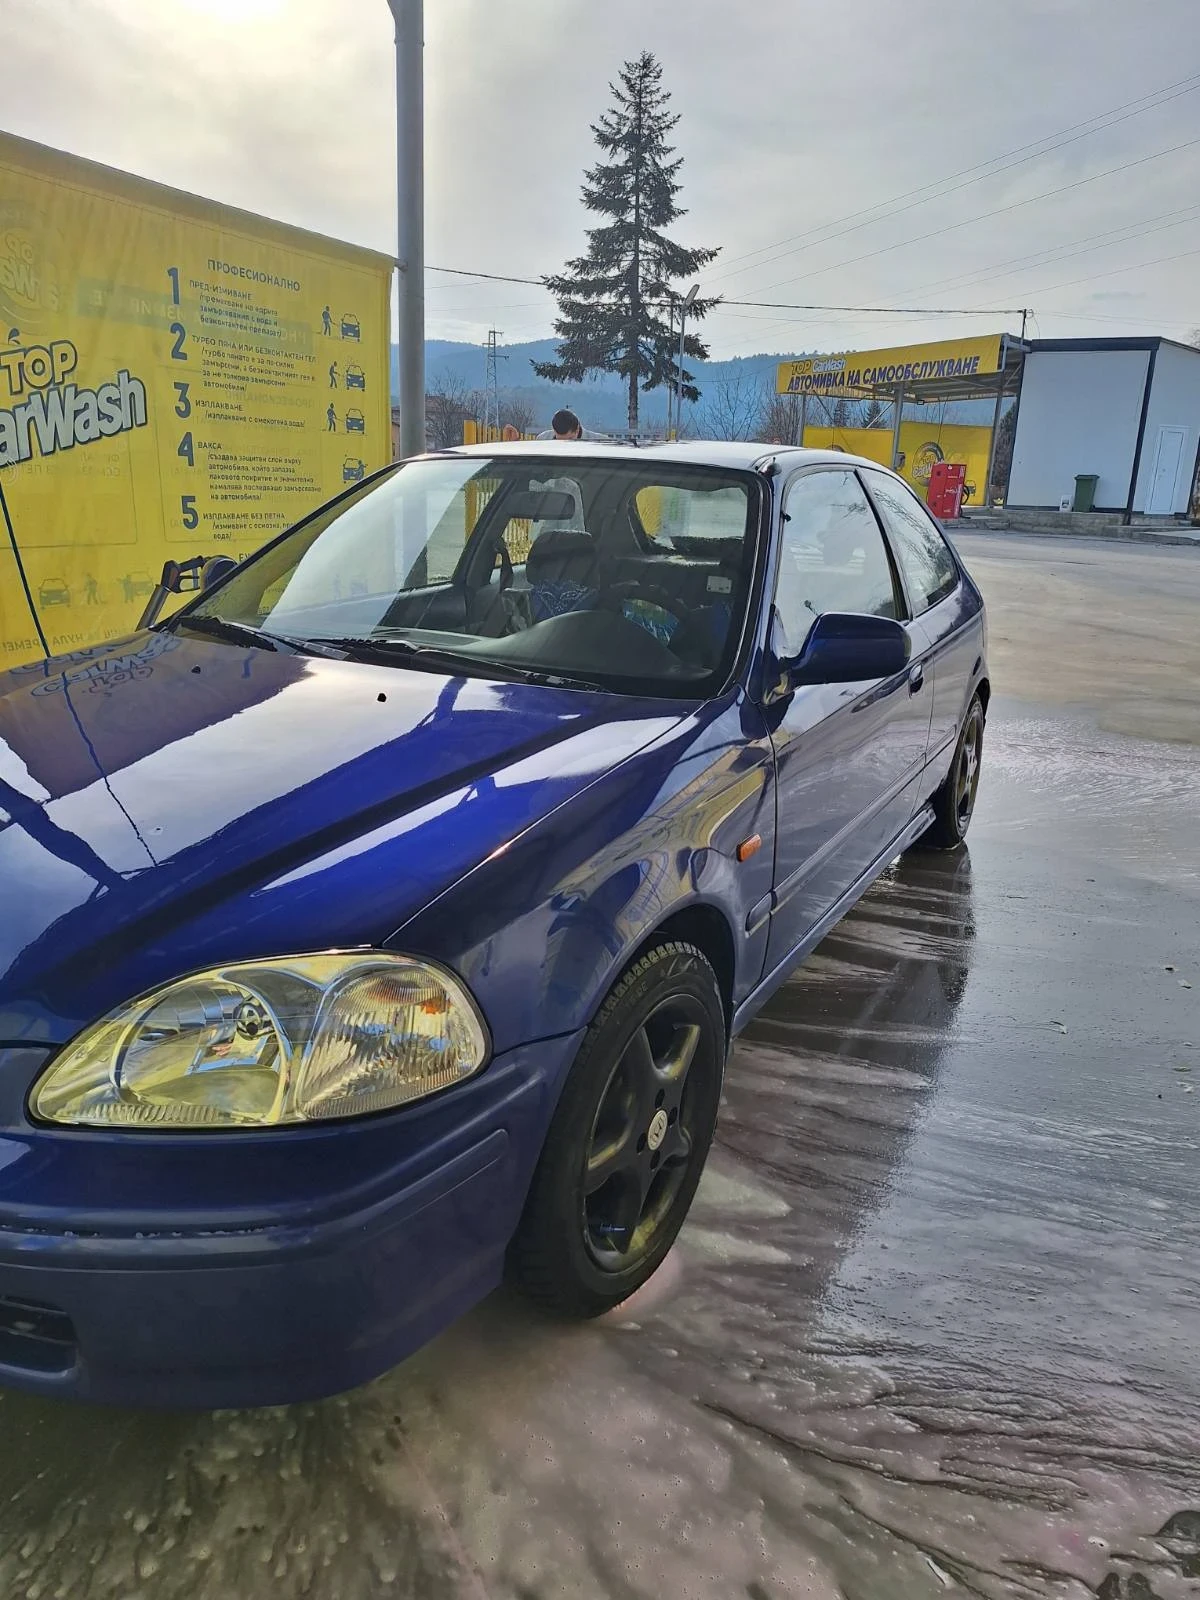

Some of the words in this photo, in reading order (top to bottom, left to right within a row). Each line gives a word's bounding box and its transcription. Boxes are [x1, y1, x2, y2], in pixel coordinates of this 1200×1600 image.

[207, 259, 301, 292] ПРОФЕСИОНАЛНО
[167, 267, 180, 305] 1
[200, 314, 248, 332] безконтактен
[256, 316, 272, 326] вода
[170, 322, 188, 360] 2
[192, 334, 215, 346] ТУРБО
[218, 339, 237, 350] ПЯНА
[238, 342, 254, 353] ИЛИ
[255, 345, 304, 361] БЕЗКОНТАКТЕН
[201, 347, 225, 358] /турбо
[0, 340, 77, 395] TOP
[787, 371, 845, 391] АВТОМИВКА
[847, 368, 861, 386] НА
[863, 356, 980, 383] САМООБСЛУЖВАНЕ
[792, 359, 812, 375] TOP
[812, 359, 846, 373] CarWash
[203, 380, 247, 392] автомобили/
[223, 372, 249, 383] толкова
[251, 376, 286, 387] замърсени
[174, 381, 191, 419] 3
[0, 369, 148, 468] arWash
[205, 411, 247, 422] /изплакване
[177, 431, 194, 467] 4
[239, 454, 266, 463] защитен
[268, 454, 283, 464] слой
[285, 457, 301, 465] върху
[251, 465, 271, 473] който
[242, 475, 272, 483] покритие
[210, 483, 243, 491] намалява
[181, 495, 199, 529] 5
[203, 512, 250, 521] ИЗПЛАКВАНЕ
[251, 512, 263, 520] БЕЗ
[213, 521, 247, 530] /измиване
[214, 532, 232, 541] вода/
